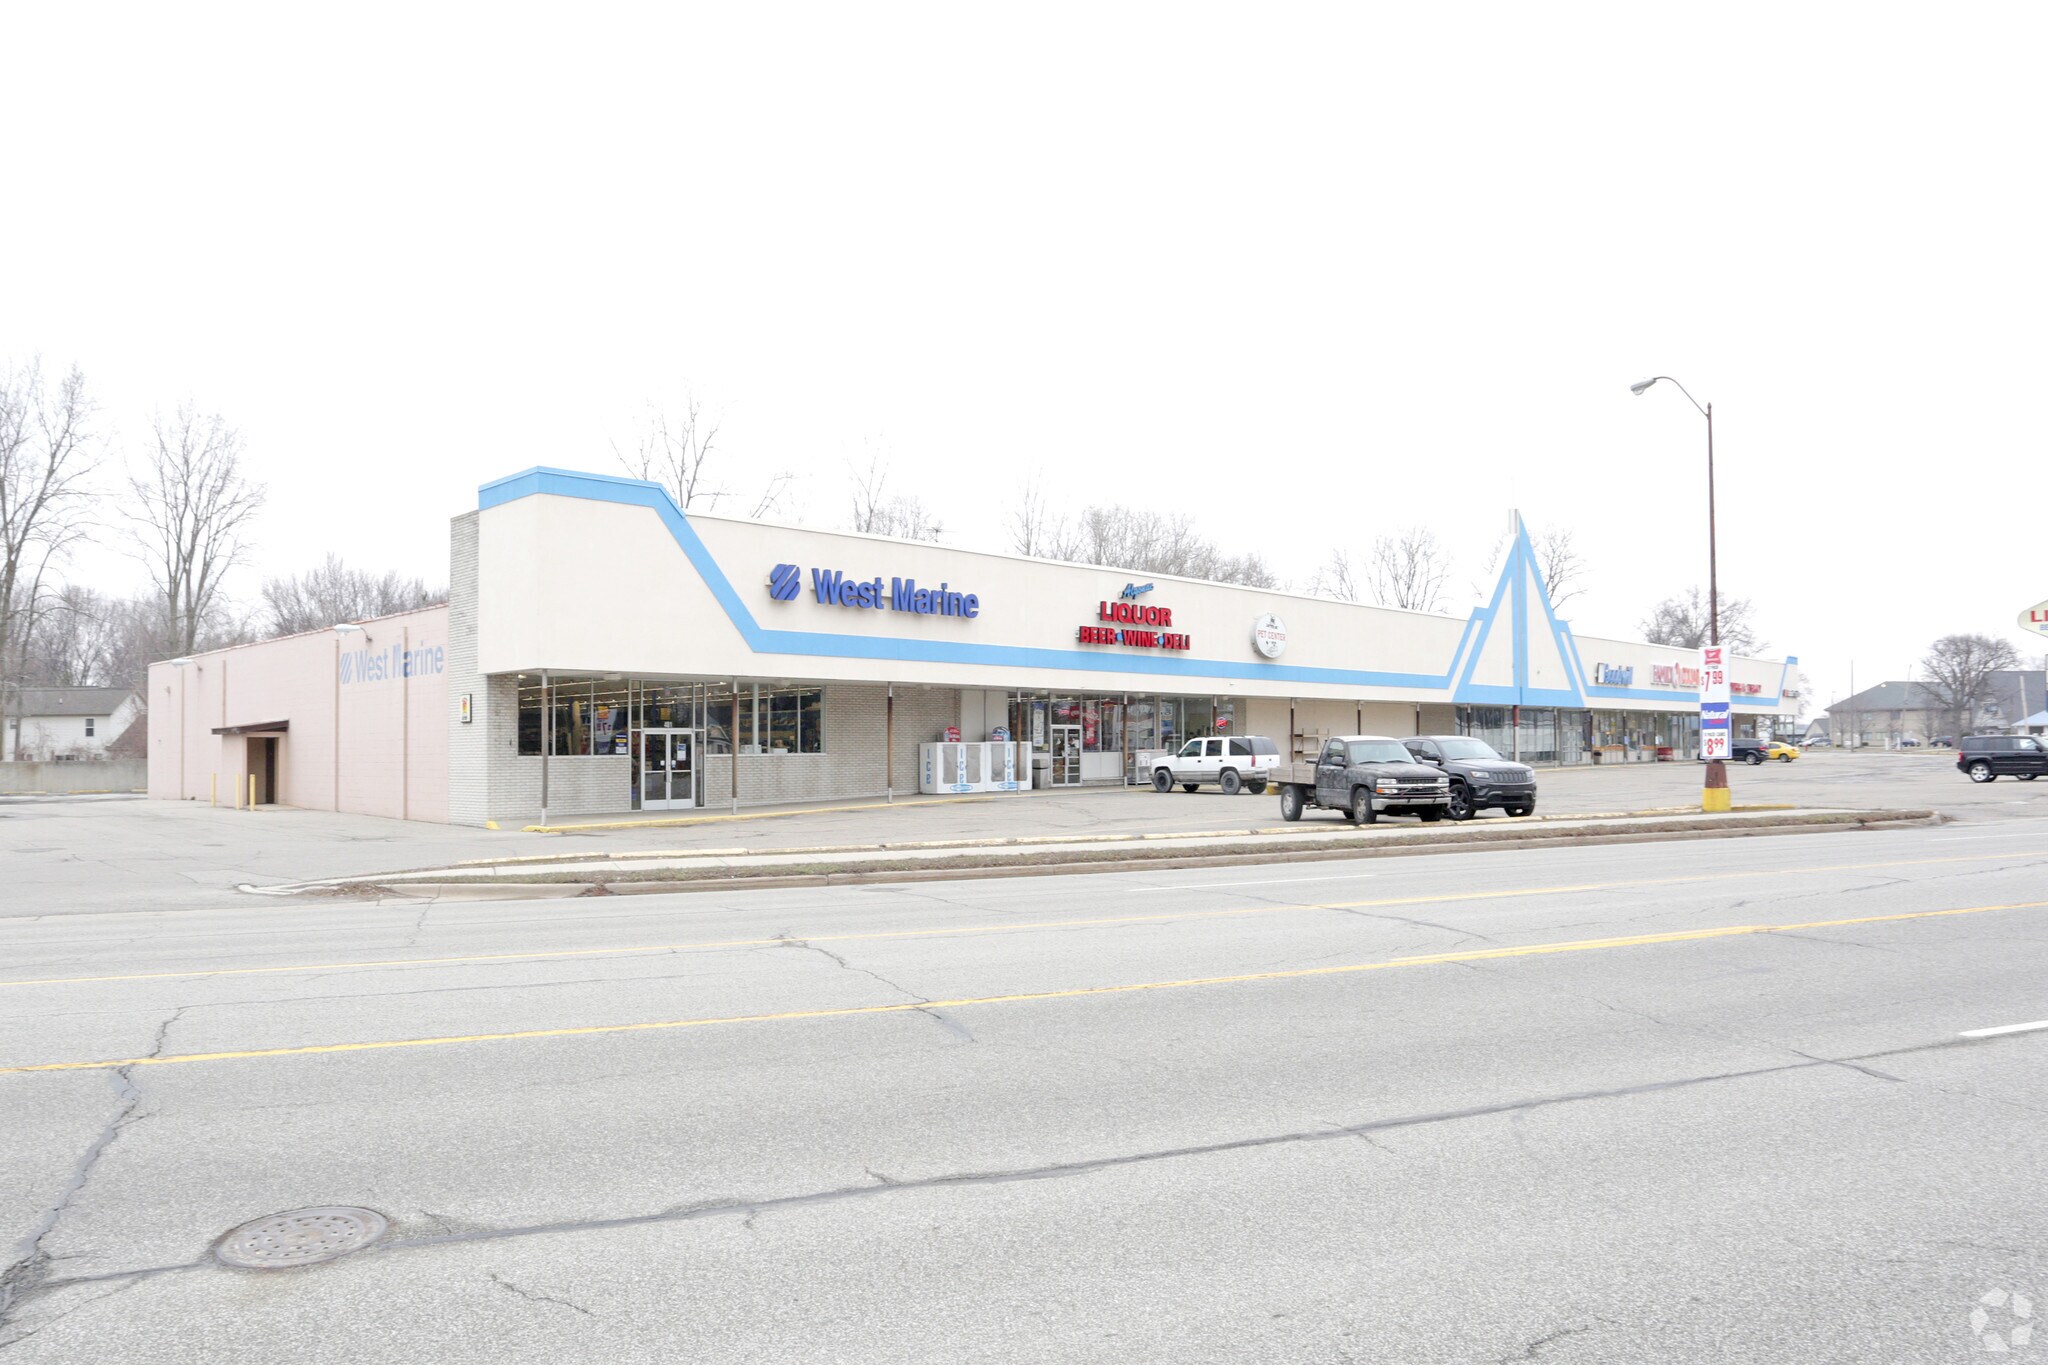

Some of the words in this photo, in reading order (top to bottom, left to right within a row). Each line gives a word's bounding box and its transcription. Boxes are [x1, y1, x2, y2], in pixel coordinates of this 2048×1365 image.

[811, 567, 885, 610] West
[891, 576, 980, 619] Marine
[1100, 600, 1172, 627] LIQUOR
[1079, 626, 1116, 645] BEER
[1122, 629, 1158, 648] WINE
[1162, 633, 1190, 651] DELI
[1257, 629, 1267, 638] PET
[1267, 631, 1286, 641] CENTER
[355, 647, 389, 682] West
[392, 641, 444, 679] Marine
